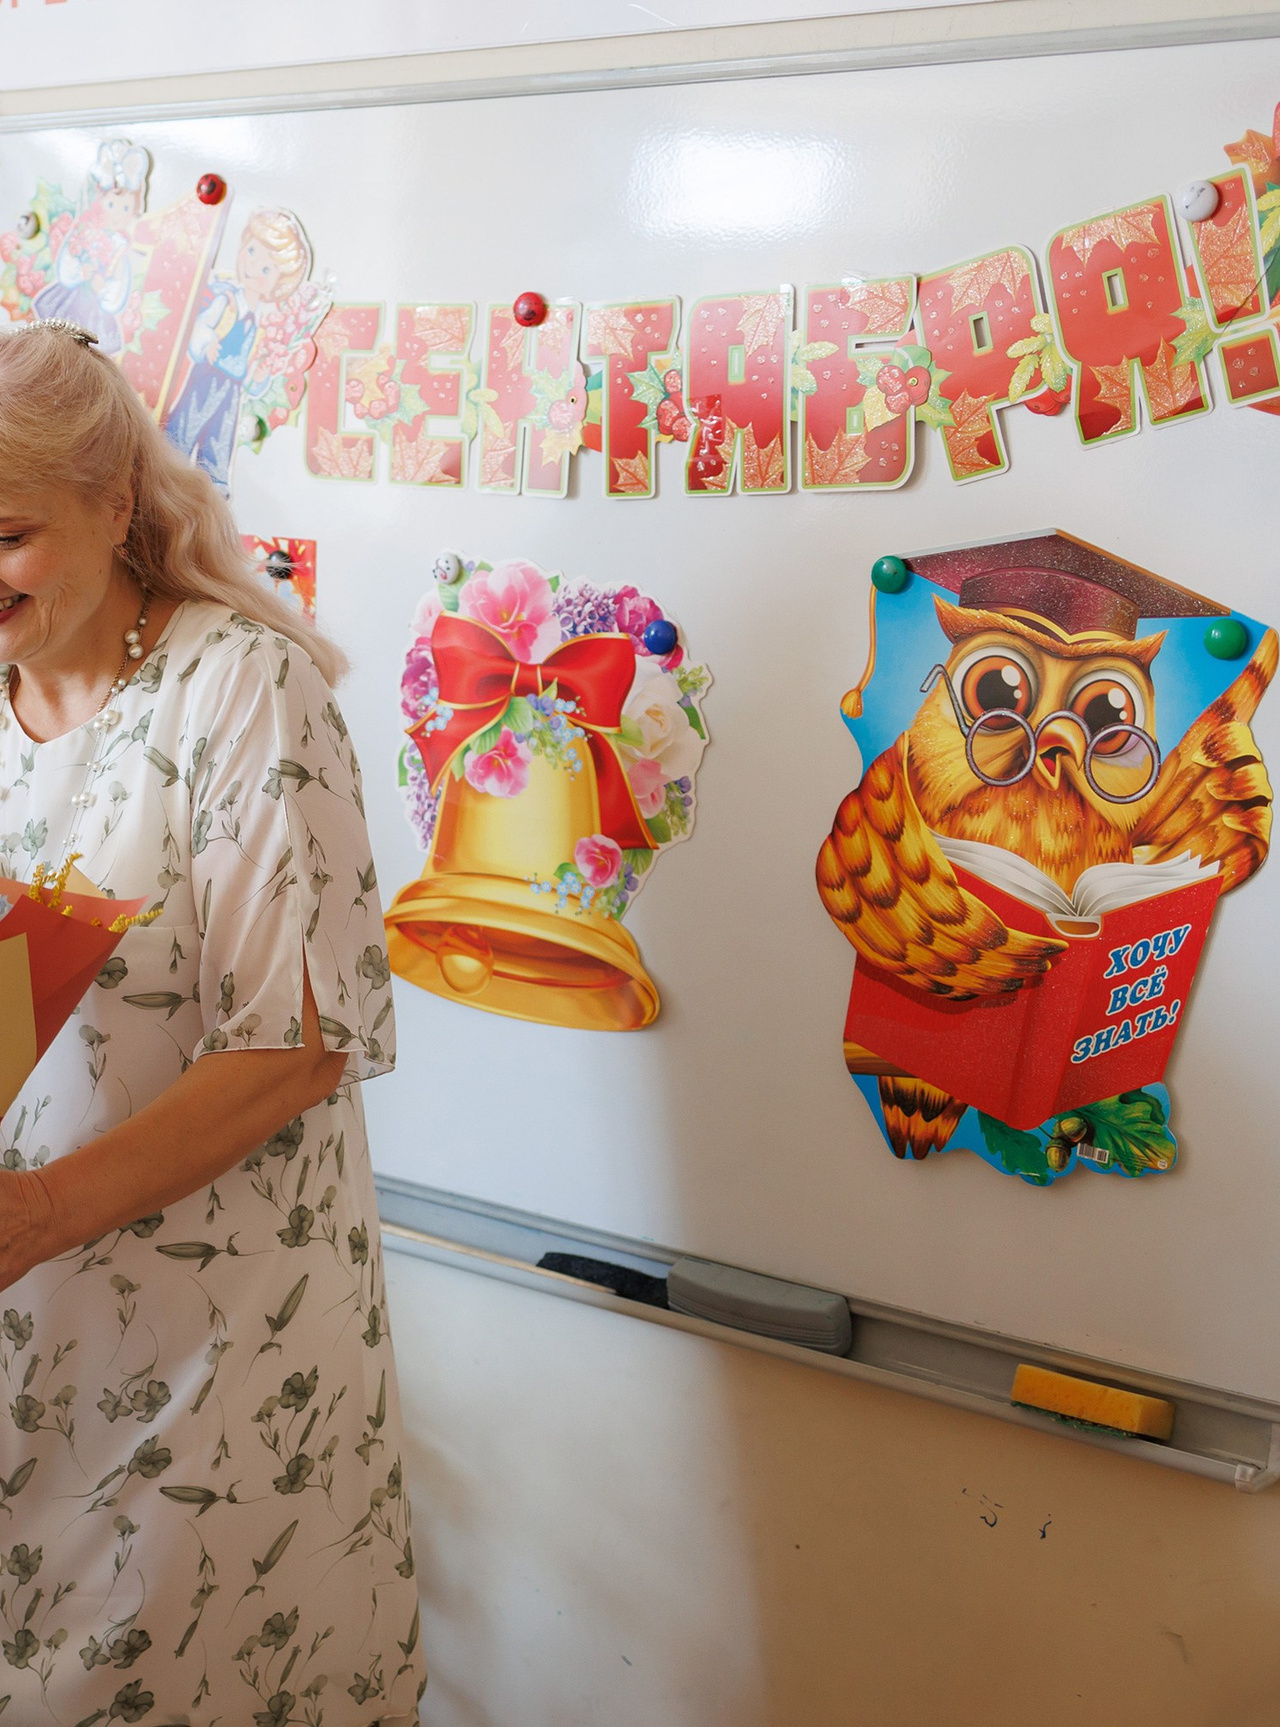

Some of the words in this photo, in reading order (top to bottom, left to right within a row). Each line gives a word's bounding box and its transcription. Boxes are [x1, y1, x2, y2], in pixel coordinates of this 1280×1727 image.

[303, 162, 1280, 500] СЕНТЯБРЯ!
[1104, 924, 1191, 978] ХОЧУ
[1106, 965, 1168, 1015] ВСЁ
[1071, 999, 1180, 1063] ЗНАТЬ!
